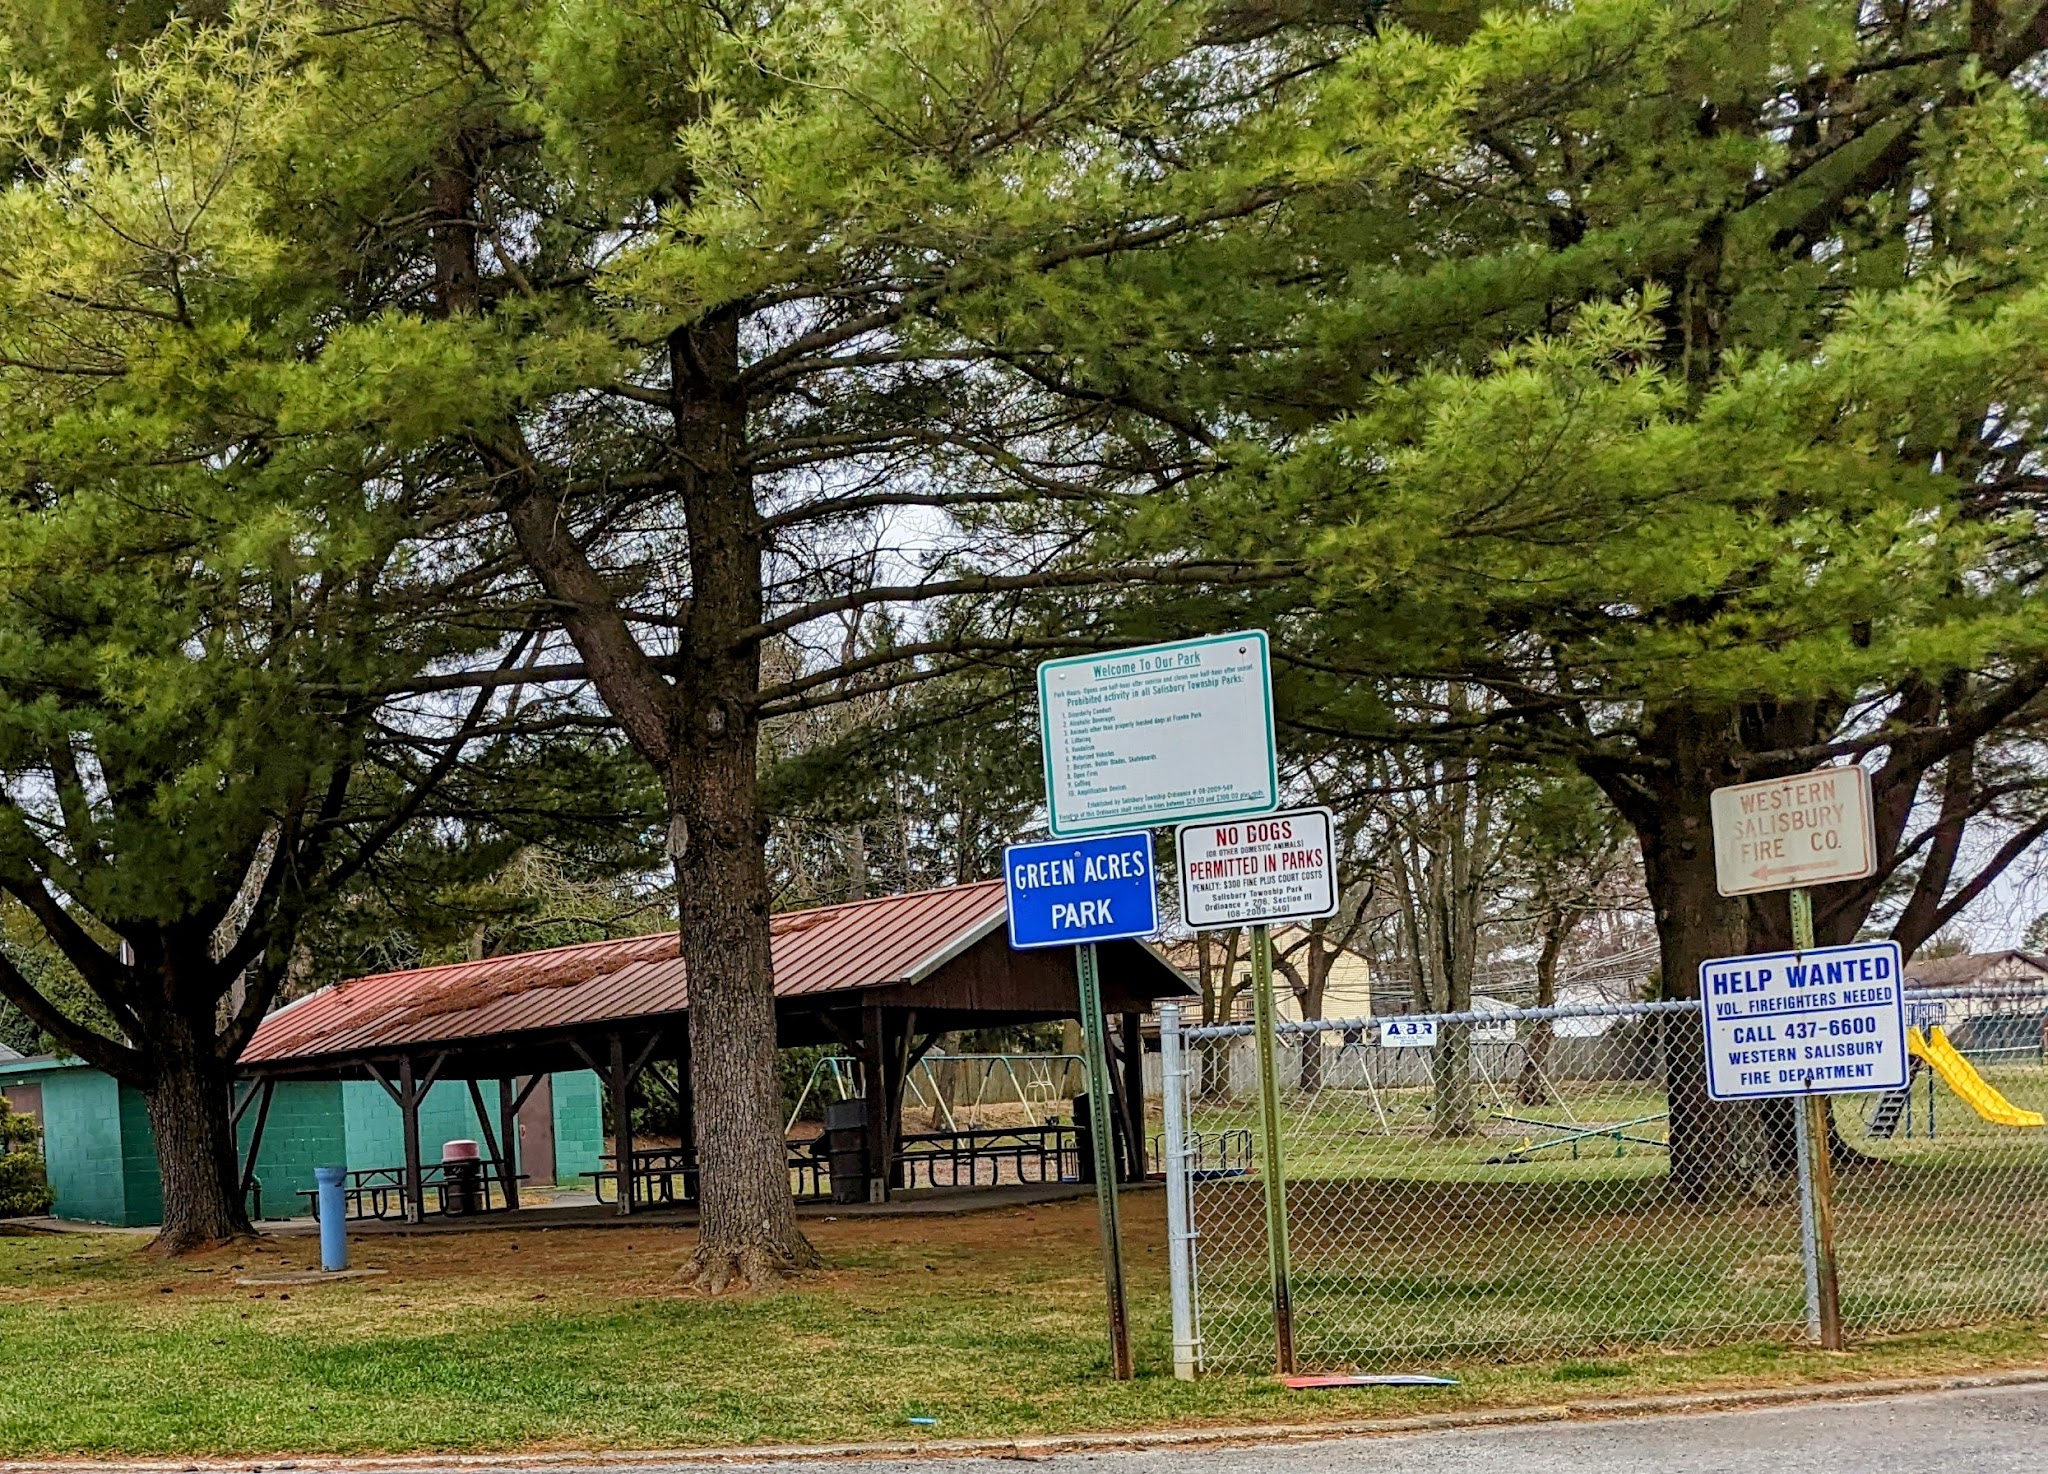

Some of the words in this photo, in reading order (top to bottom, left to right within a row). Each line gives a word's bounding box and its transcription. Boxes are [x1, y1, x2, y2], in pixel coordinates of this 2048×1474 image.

[1093, 662, 1136, 678] Welcome
[1140, 658, 1151, 672] To
[1155, 656, 1173, 669] Our
[1177, 651, 1201, 666] Park
[1054, 690, 1065, 698] Park
[1224, 666, 1236, 674] after
[1067, 694, 1102, 707] Prohibited
[1104, 691, 1129, 702] activity
[1132, 690, 1139, 698] in
[1142, 687, 1150, 696] all
[1153, 684, 1185, 695] Salisbury
[1188, 678, 1219, 690] Township
[1115, 722, 1134, 730] properly
[1072, 753, 1094, 761] Motorized
[1074, 780, 1091, 788] Golfing
[1078, 787, 1107, 796] Amplification
[1740, 780, 1836, 814] WESTERN
[1122, 796, 1143, 804] Salisbury
[1145, 793, 1166, 801] Township
[1167, 791, 1191, 799] Ordinance
[1216, 827, 1238, 847] NO
[1247, 821, 1292, 843] DOGS
[1734, 804, 1844, 840] SALISBURY
[1219, 848, 1238, 857] OTHER
[1241, 844, 1271, 854] DOMESTIC
[1273, 840, 1304, 849] ANIMALS)
[1741, 839, 1785, 863] FIRE
[1810, 830, 1841, 851] CO.
[1015, 859, 1075, 890] GREEN
[1084, 850, 1145, 883] ACRES
[1190, 856, 1258, 880] PERMITTED
[1264, 854, 1277, 873] IN
[1282, 848, 1323, 871] PARKS
[1192, 882, 1221, 893] PENALTY:
[1223, 880, 1241, 889] $300
[1243, 878, 1257, 887] FINE
[1260, 876, 1276, 886] PLUS
[1278, 873, 1299, 883] COURT
[1302, 870, 1323, 880] COSTS
[1212, 891, 1246, 901] Salisbury
[1250, 887, 1284, 897] Township
[1287, 885, 1303, 893] Park
[1051, 898, 1114, 929] PARK
[1205, 902, 1241, 911] Ordinance
[1273, 896, 1302, 905] Section
[1304, 893, 1312, 901] III
[1227, 904, 1290, 918] (08-2009-549)
[1713, 969, 1773, 995] HELP
[1785, 957, 1890, 988] WANTED
[1717, 1002, 1743, 1016] VOL.
[1749, 991, 1837, 1013] FIREFIGHTERS
[1843, 986, 1892, 1004] NEEDED
[1733, 1025, 1777, 1044] CALL
[1785, 1016, 1876, 1040] 437-6600
[1729, 1048, 1797, 1065] WESTERN
[1804, 1040, 1883, 1060] SALISBURY
[1740, 1071, 1772, 1086] FIRE
[1779, 1063, 1874, 1083] DEPARTMENT
